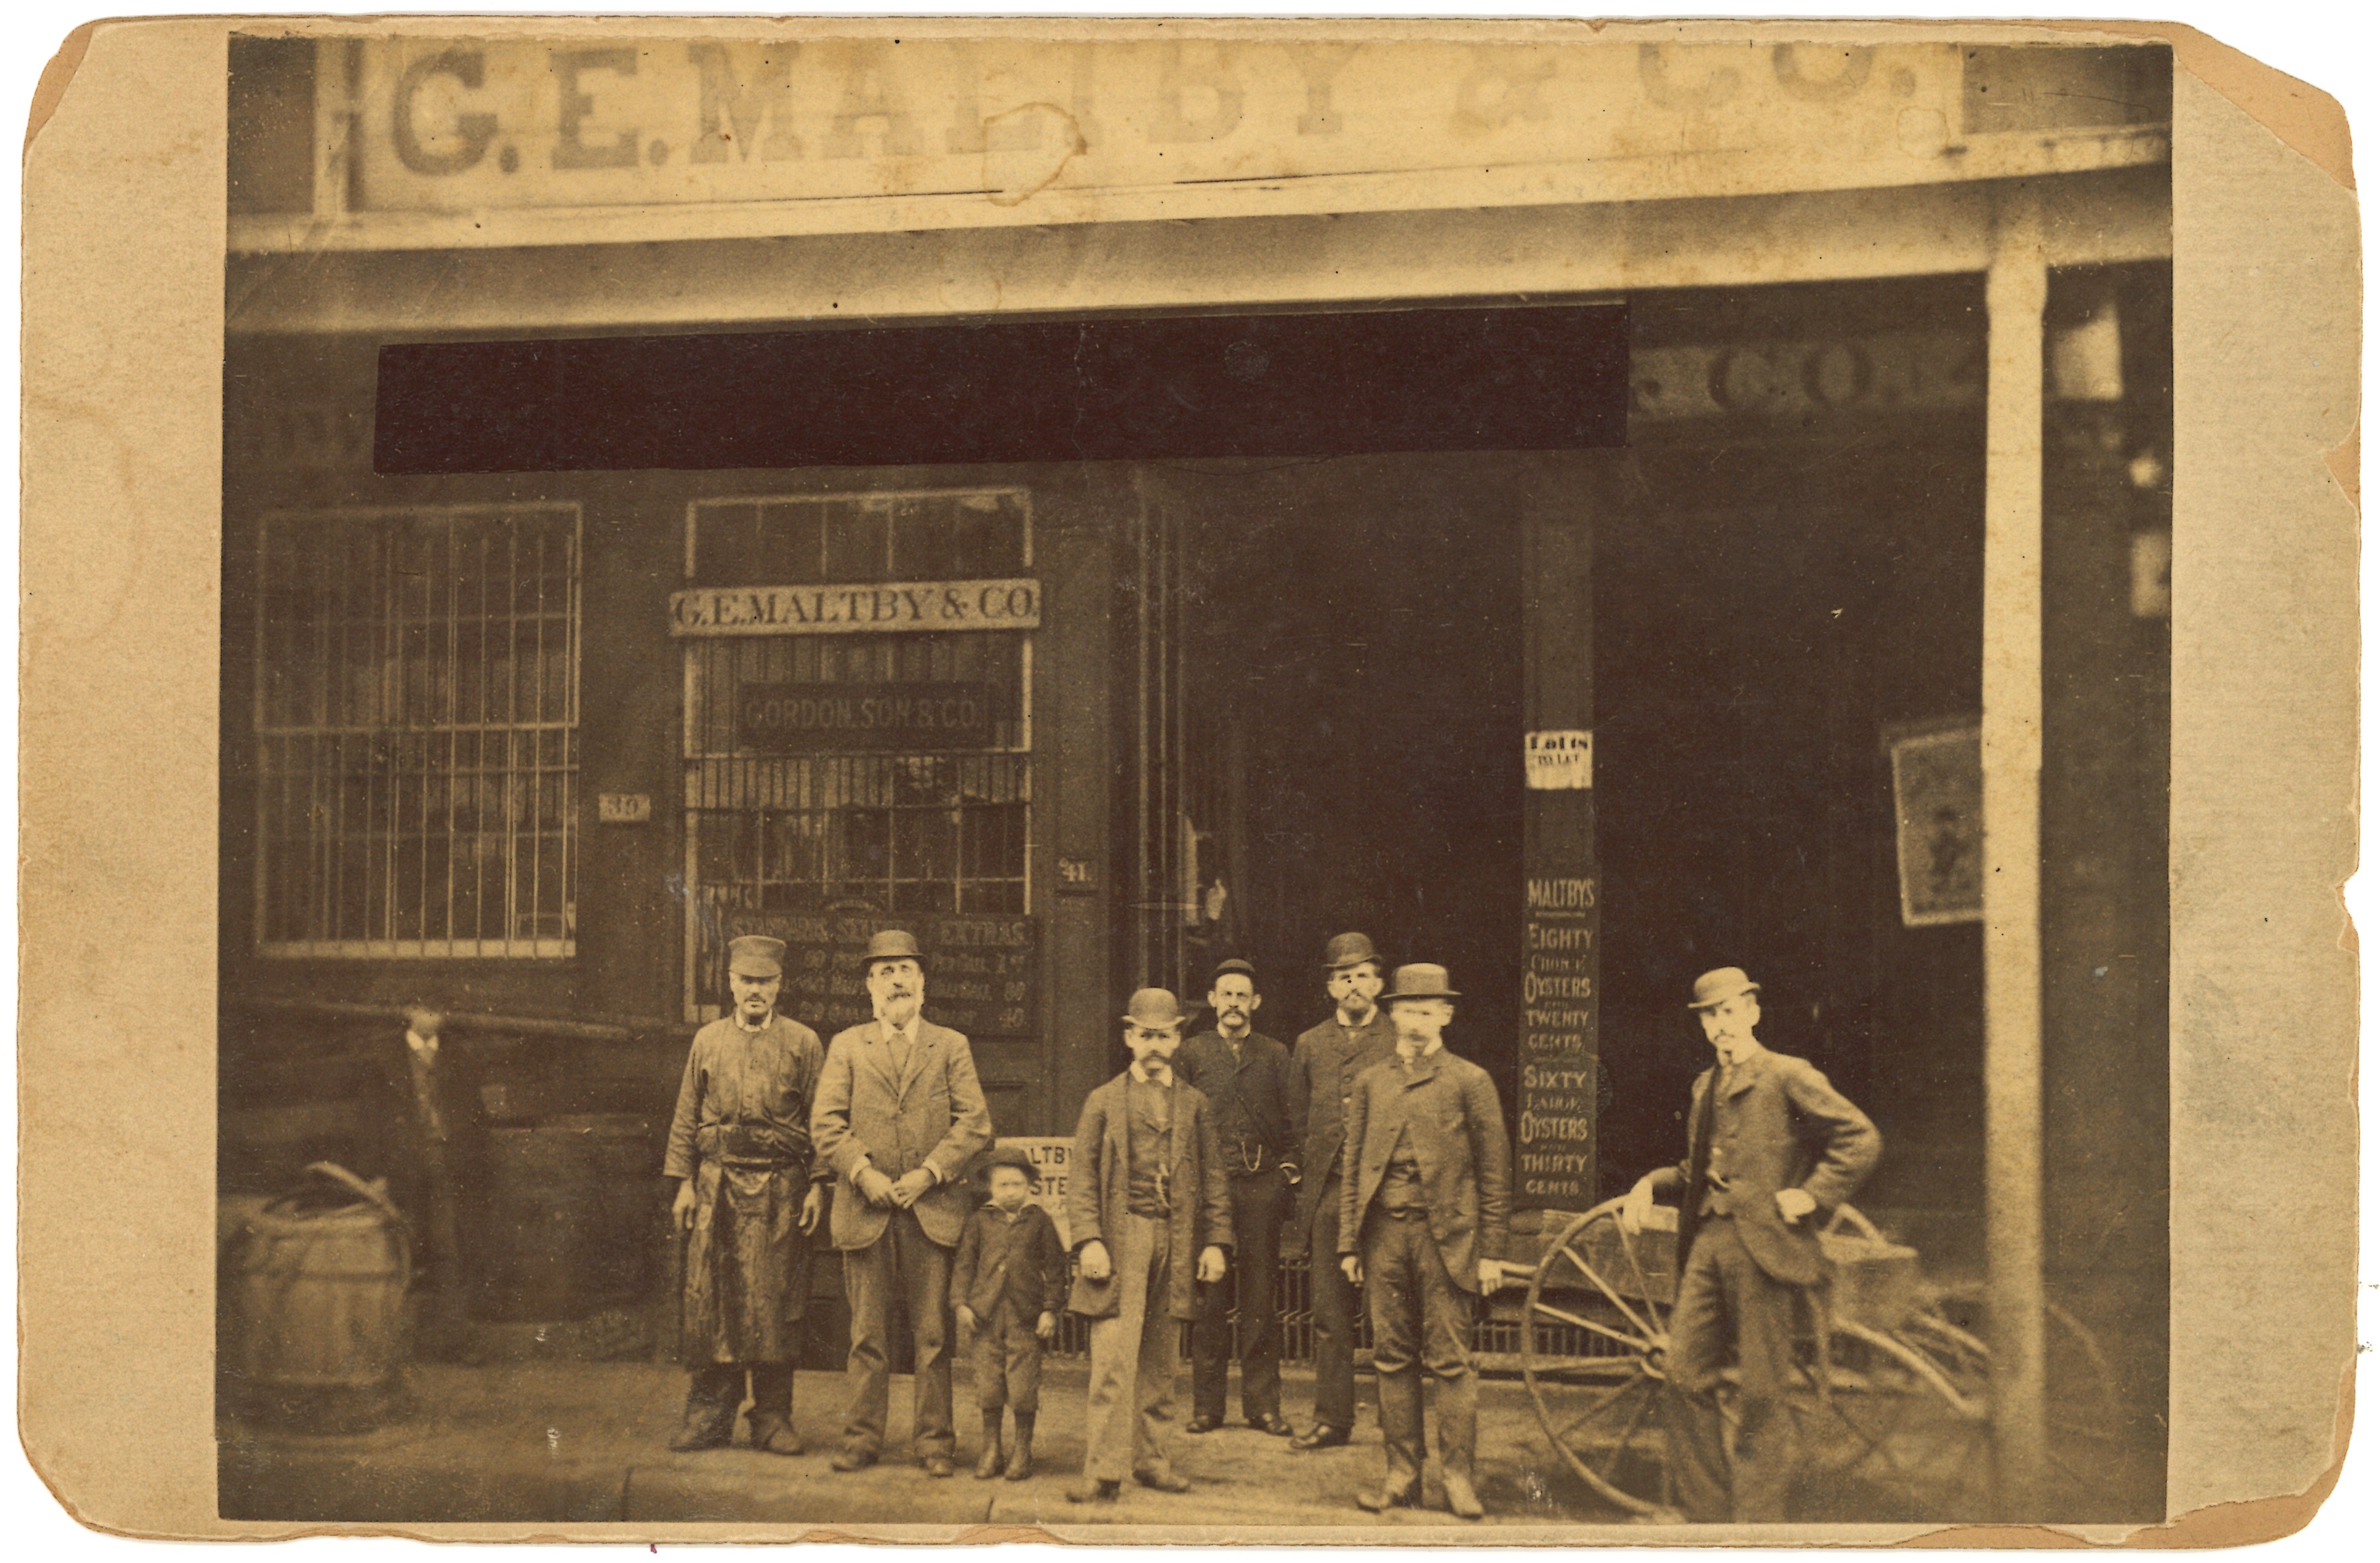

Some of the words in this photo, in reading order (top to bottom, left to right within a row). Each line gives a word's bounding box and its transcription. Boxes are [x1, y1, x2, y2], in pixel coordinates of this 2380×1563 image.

[941, 587, 969, 620] &
[917, 698, 935, 728] &
[1061, 861, 1087, 882] 41
[939, 920, 1026, 946] EXTRAS
[1527, 922, 1593, 951] EIGHTY
[1524, 971, 1591, 1004] OYSTERS
[1524, 1008, 1589, 1028] TWENTY
[1524, 1064, 1587, 1088] SIXTY
[1520, 1110, 1587, 1144] OYSTERS
[1031, 1146, 1072, 1164] LTB
[1521, 1155, 1587, 1173] THIRTY
